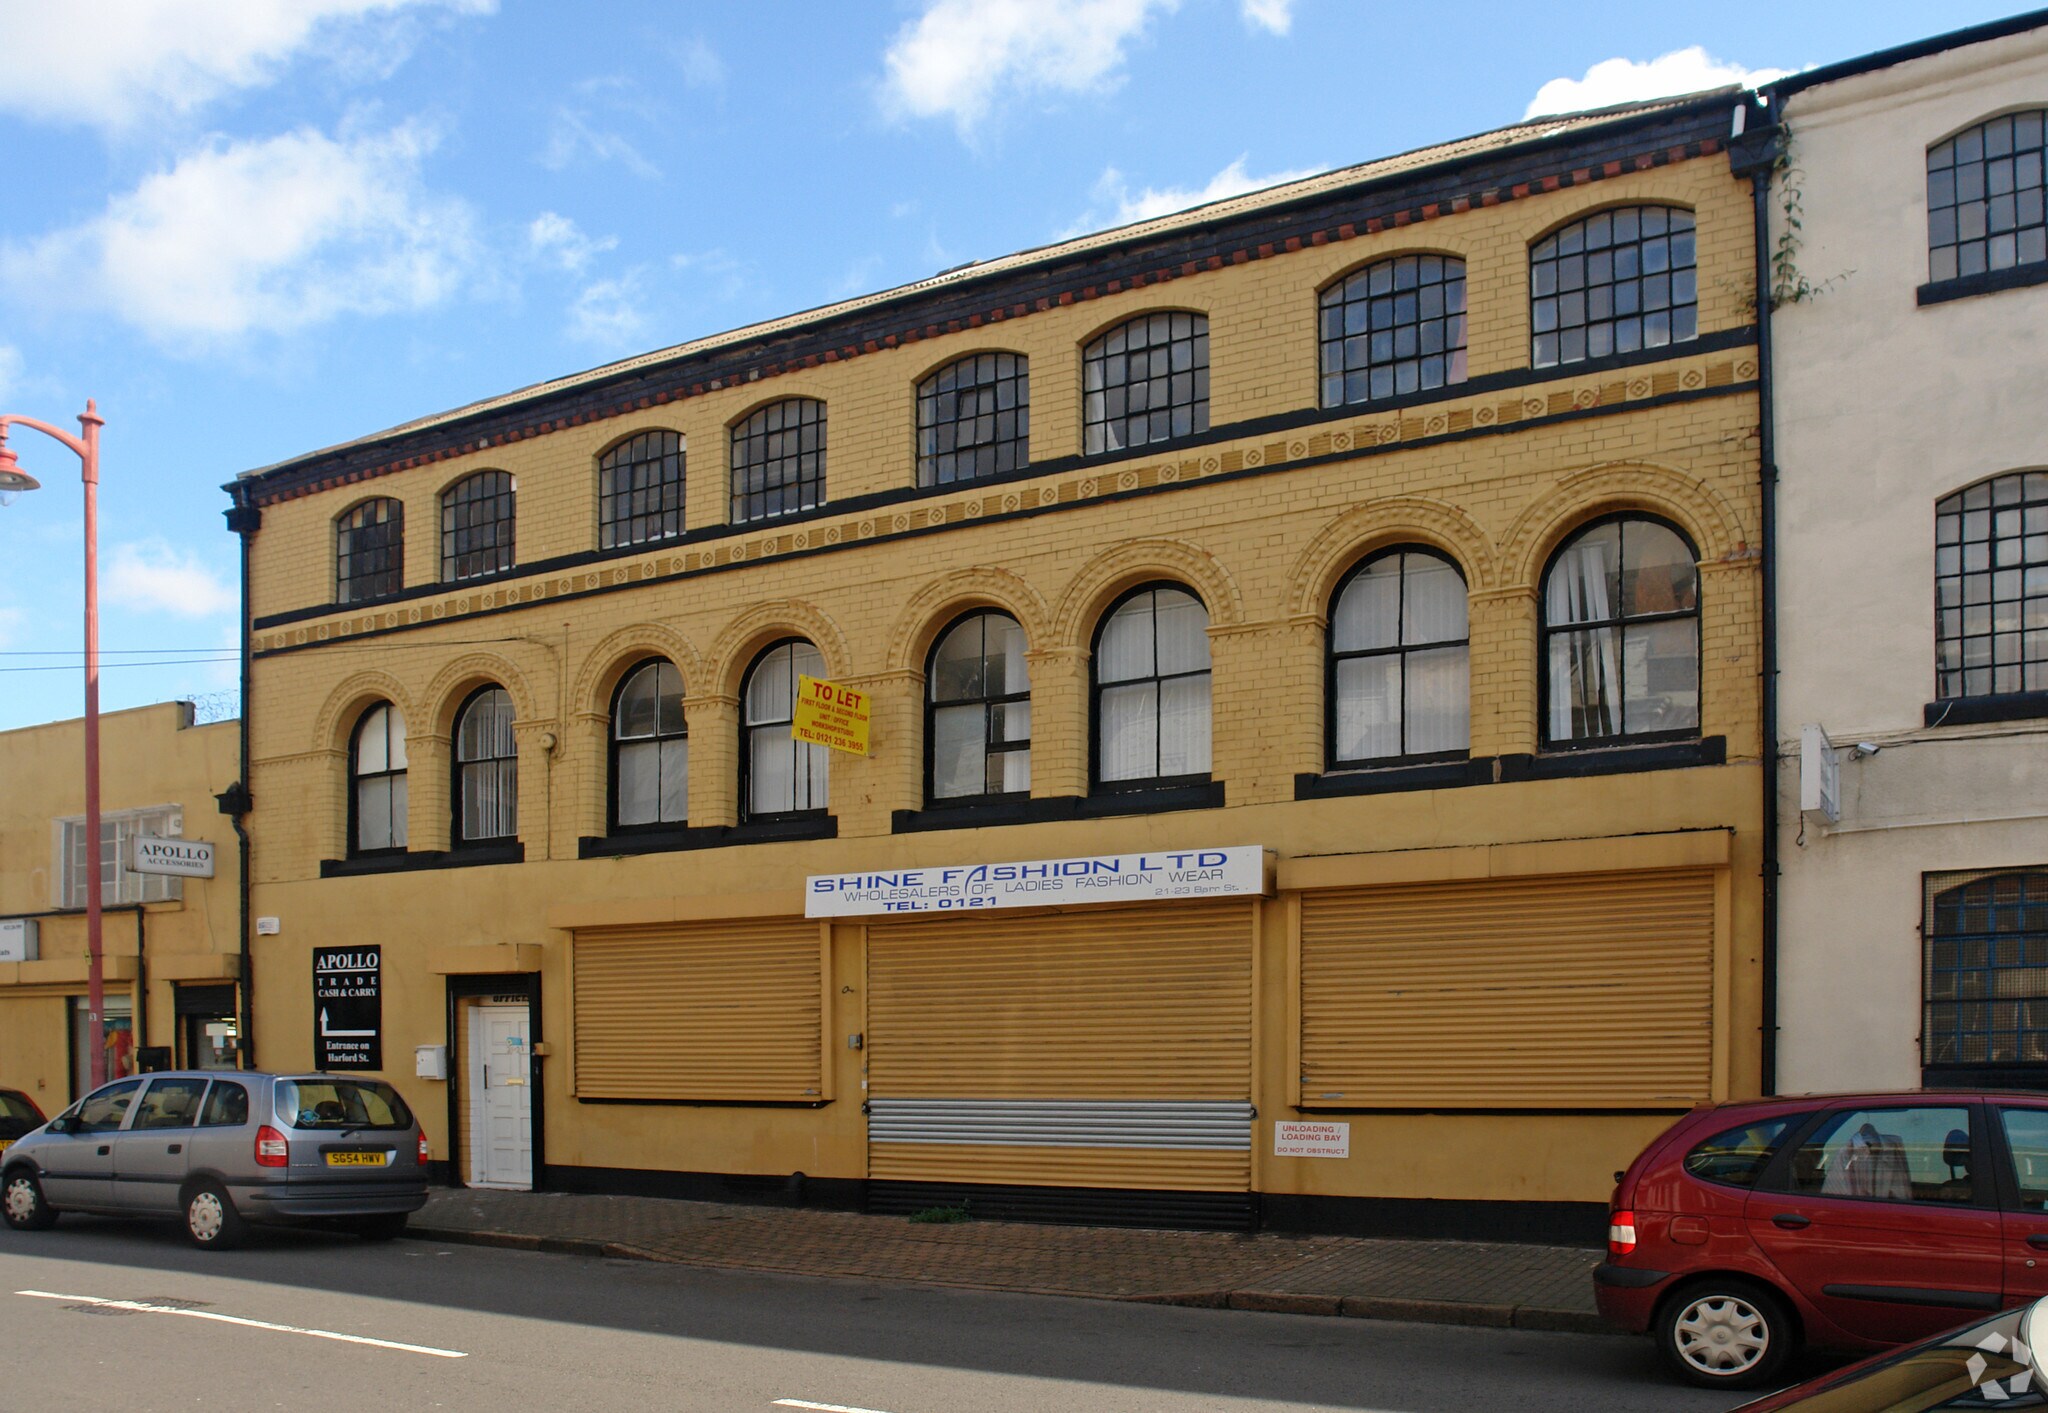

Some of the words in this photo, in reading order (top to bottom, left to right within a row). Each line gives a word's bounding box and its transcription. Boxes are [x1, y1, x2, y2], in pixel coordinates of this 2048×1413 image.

[813, 682, 833, 701] TO
[836, 689, 862, 709] LET
[801, 697, 815, 706] FIRST
[815, 701, 831, 710] FLOOR
[835, 707, 854, 718] SECOND
[854, 712, 868, 721] FLOOR
[833, 716, 849, 726] OFFICE
[799, 727, 814, 739] TEL:
[816, 732, 832, 743] 0121
[834, 737, 846, 747] 236
[847, 740, 864, 751] 3955
[139, 844, 209, 861] APOLLO
[147, 857, 204, 868] ACCESSORIES
[813, 872, 924, 894] SHINE
[943, 858, 1120, 896] FASHION
[1140, 852, 1228, 872] LTD
[844, 885, 960, 903] WHOLESALERS
[971, 883, 994, 895] OF
[1005, 878, 1064, 893] LADIES
[1075, 872, 1153, 888] FASHION
[1168, 868, 1224, 883] WEAR
[1155, 886, 1190, 896] 21-23
[883, 901, 929, 911] TEL:
[938, 896, 997, 909] 0121
[316, 952, 379, 970] APOLLO
[318, 988, 339, 998] CASH
[340, 988, 347, 997] &
[348, 987, 377, 997] CARRY
[326, 1040, 359, 1050] Entrance
[328, 1053, 358, 1062] Harford
[358, 1053, 369, 1062] St.
[1282, 1125, 1334, 1133] UNLOADING
[1281, 1133, 1321, 1141] LOADING
[1306, 1147, 1345, 1155] OBSTRUCT
[332, 1153, 359, 1163] SG54
[361, 1153, 381, 1163] HWV
